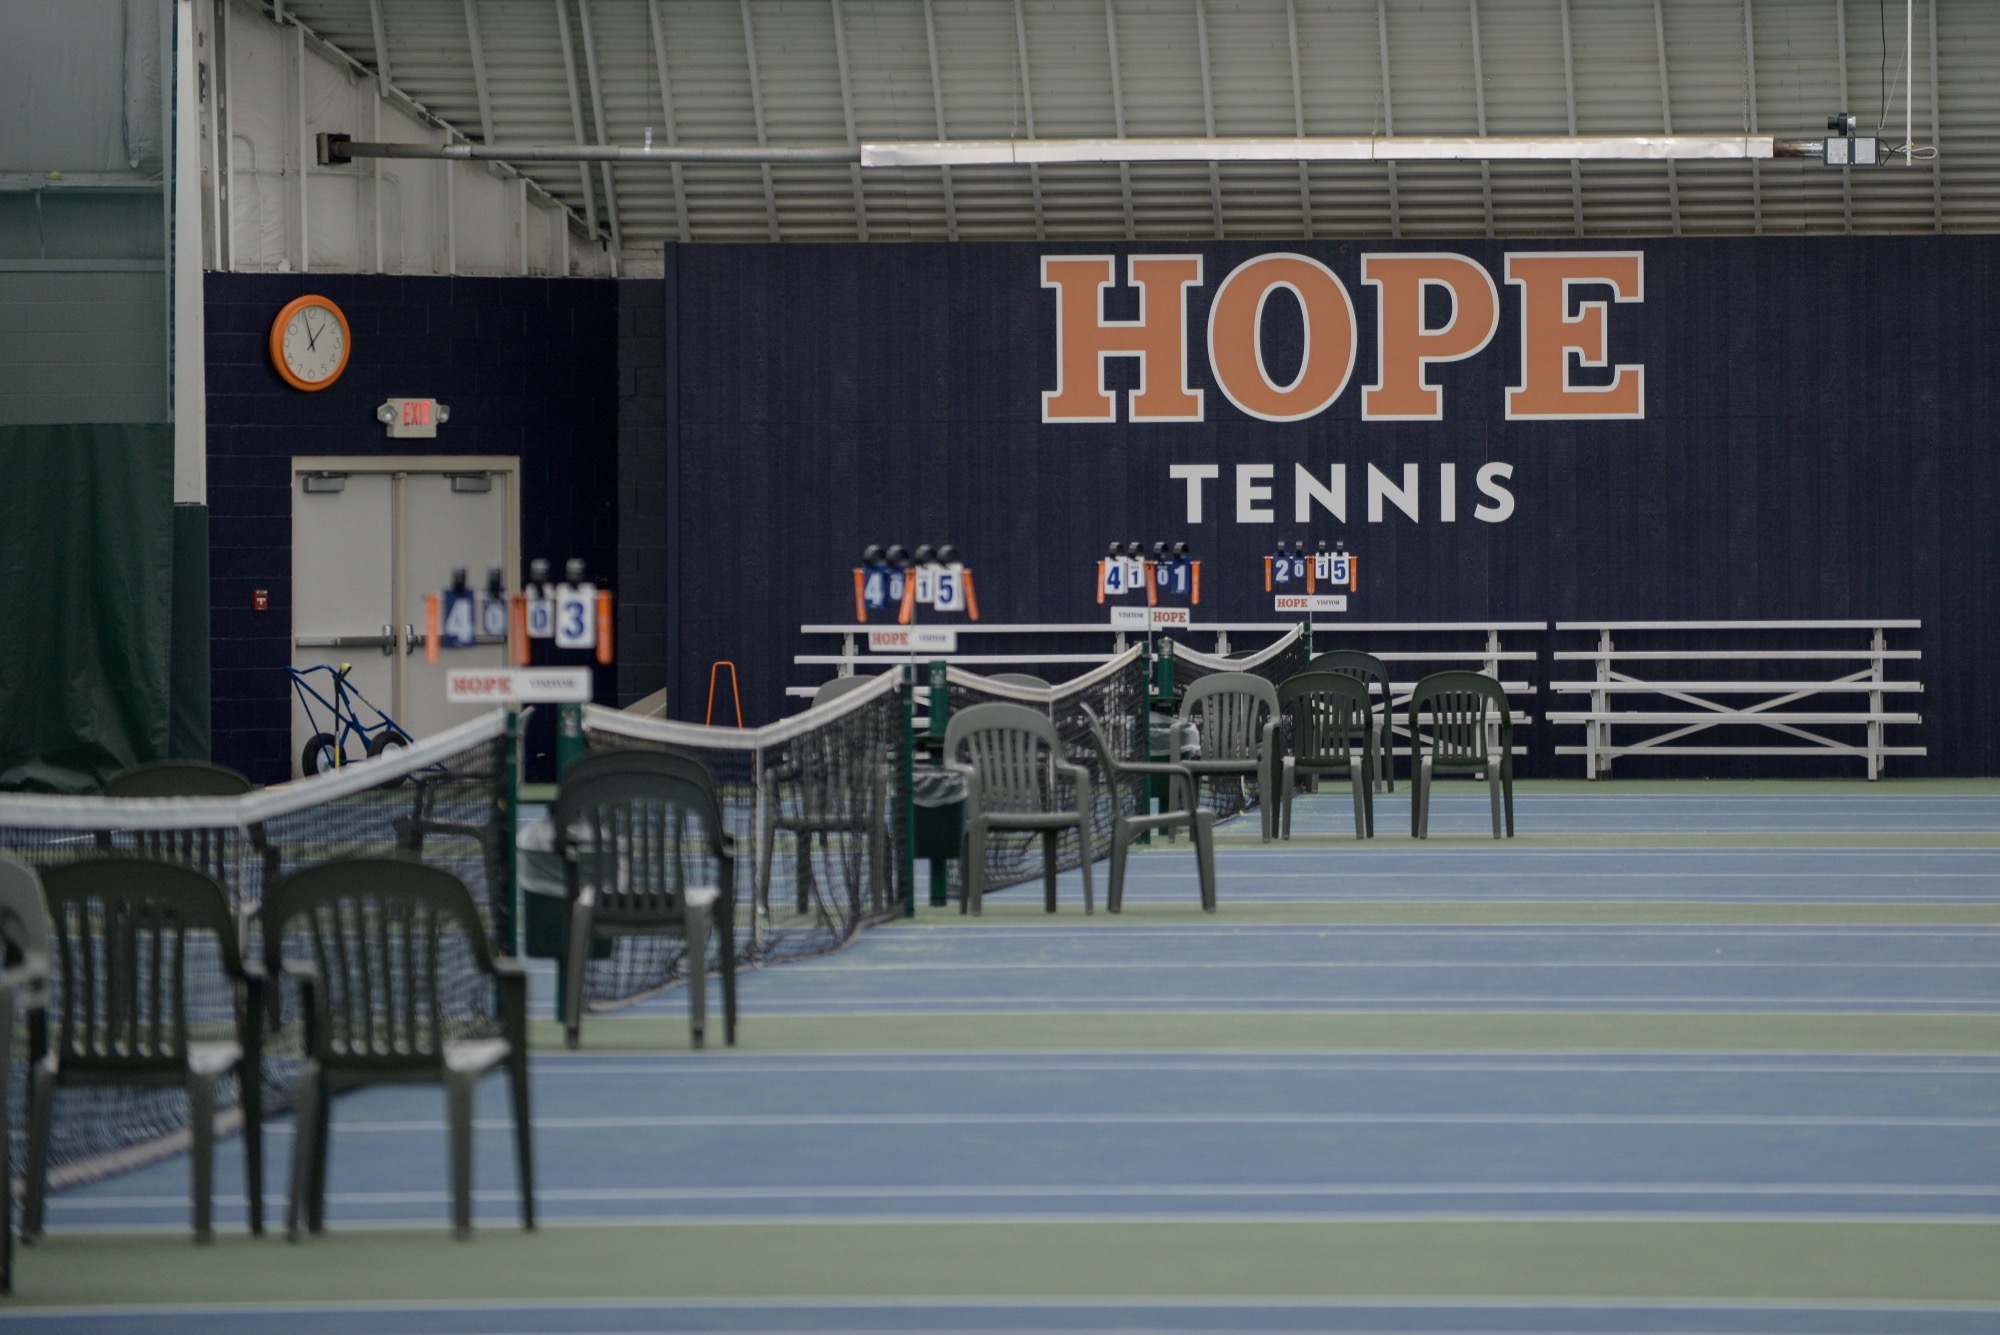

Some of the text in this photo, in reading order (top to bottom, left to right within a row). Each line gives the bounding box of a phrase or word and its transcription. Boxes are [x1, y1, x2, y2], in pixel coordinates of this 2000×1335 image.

[1040, 251, 1645, 423] HOPE
[403, 401, 430, 426] EXIT
[1169, 462, 1515, 523] TENNIS
[1107, 565, 1186, 591] 4 1 0 1
[1275, 559, 1346, 581] 2 0 1 5
[864, 573, 953, 606] 4 0 1 5
[1277, 598, 1308, 608] HOPE
[445, 599, 584, 643] 4 0 0 3
[1153, 611, 1186, 622] HOPE
[872, 632, 947, 646] HOPE VISITOR
[452, 676, 576, 694] HOPE VISITOR
